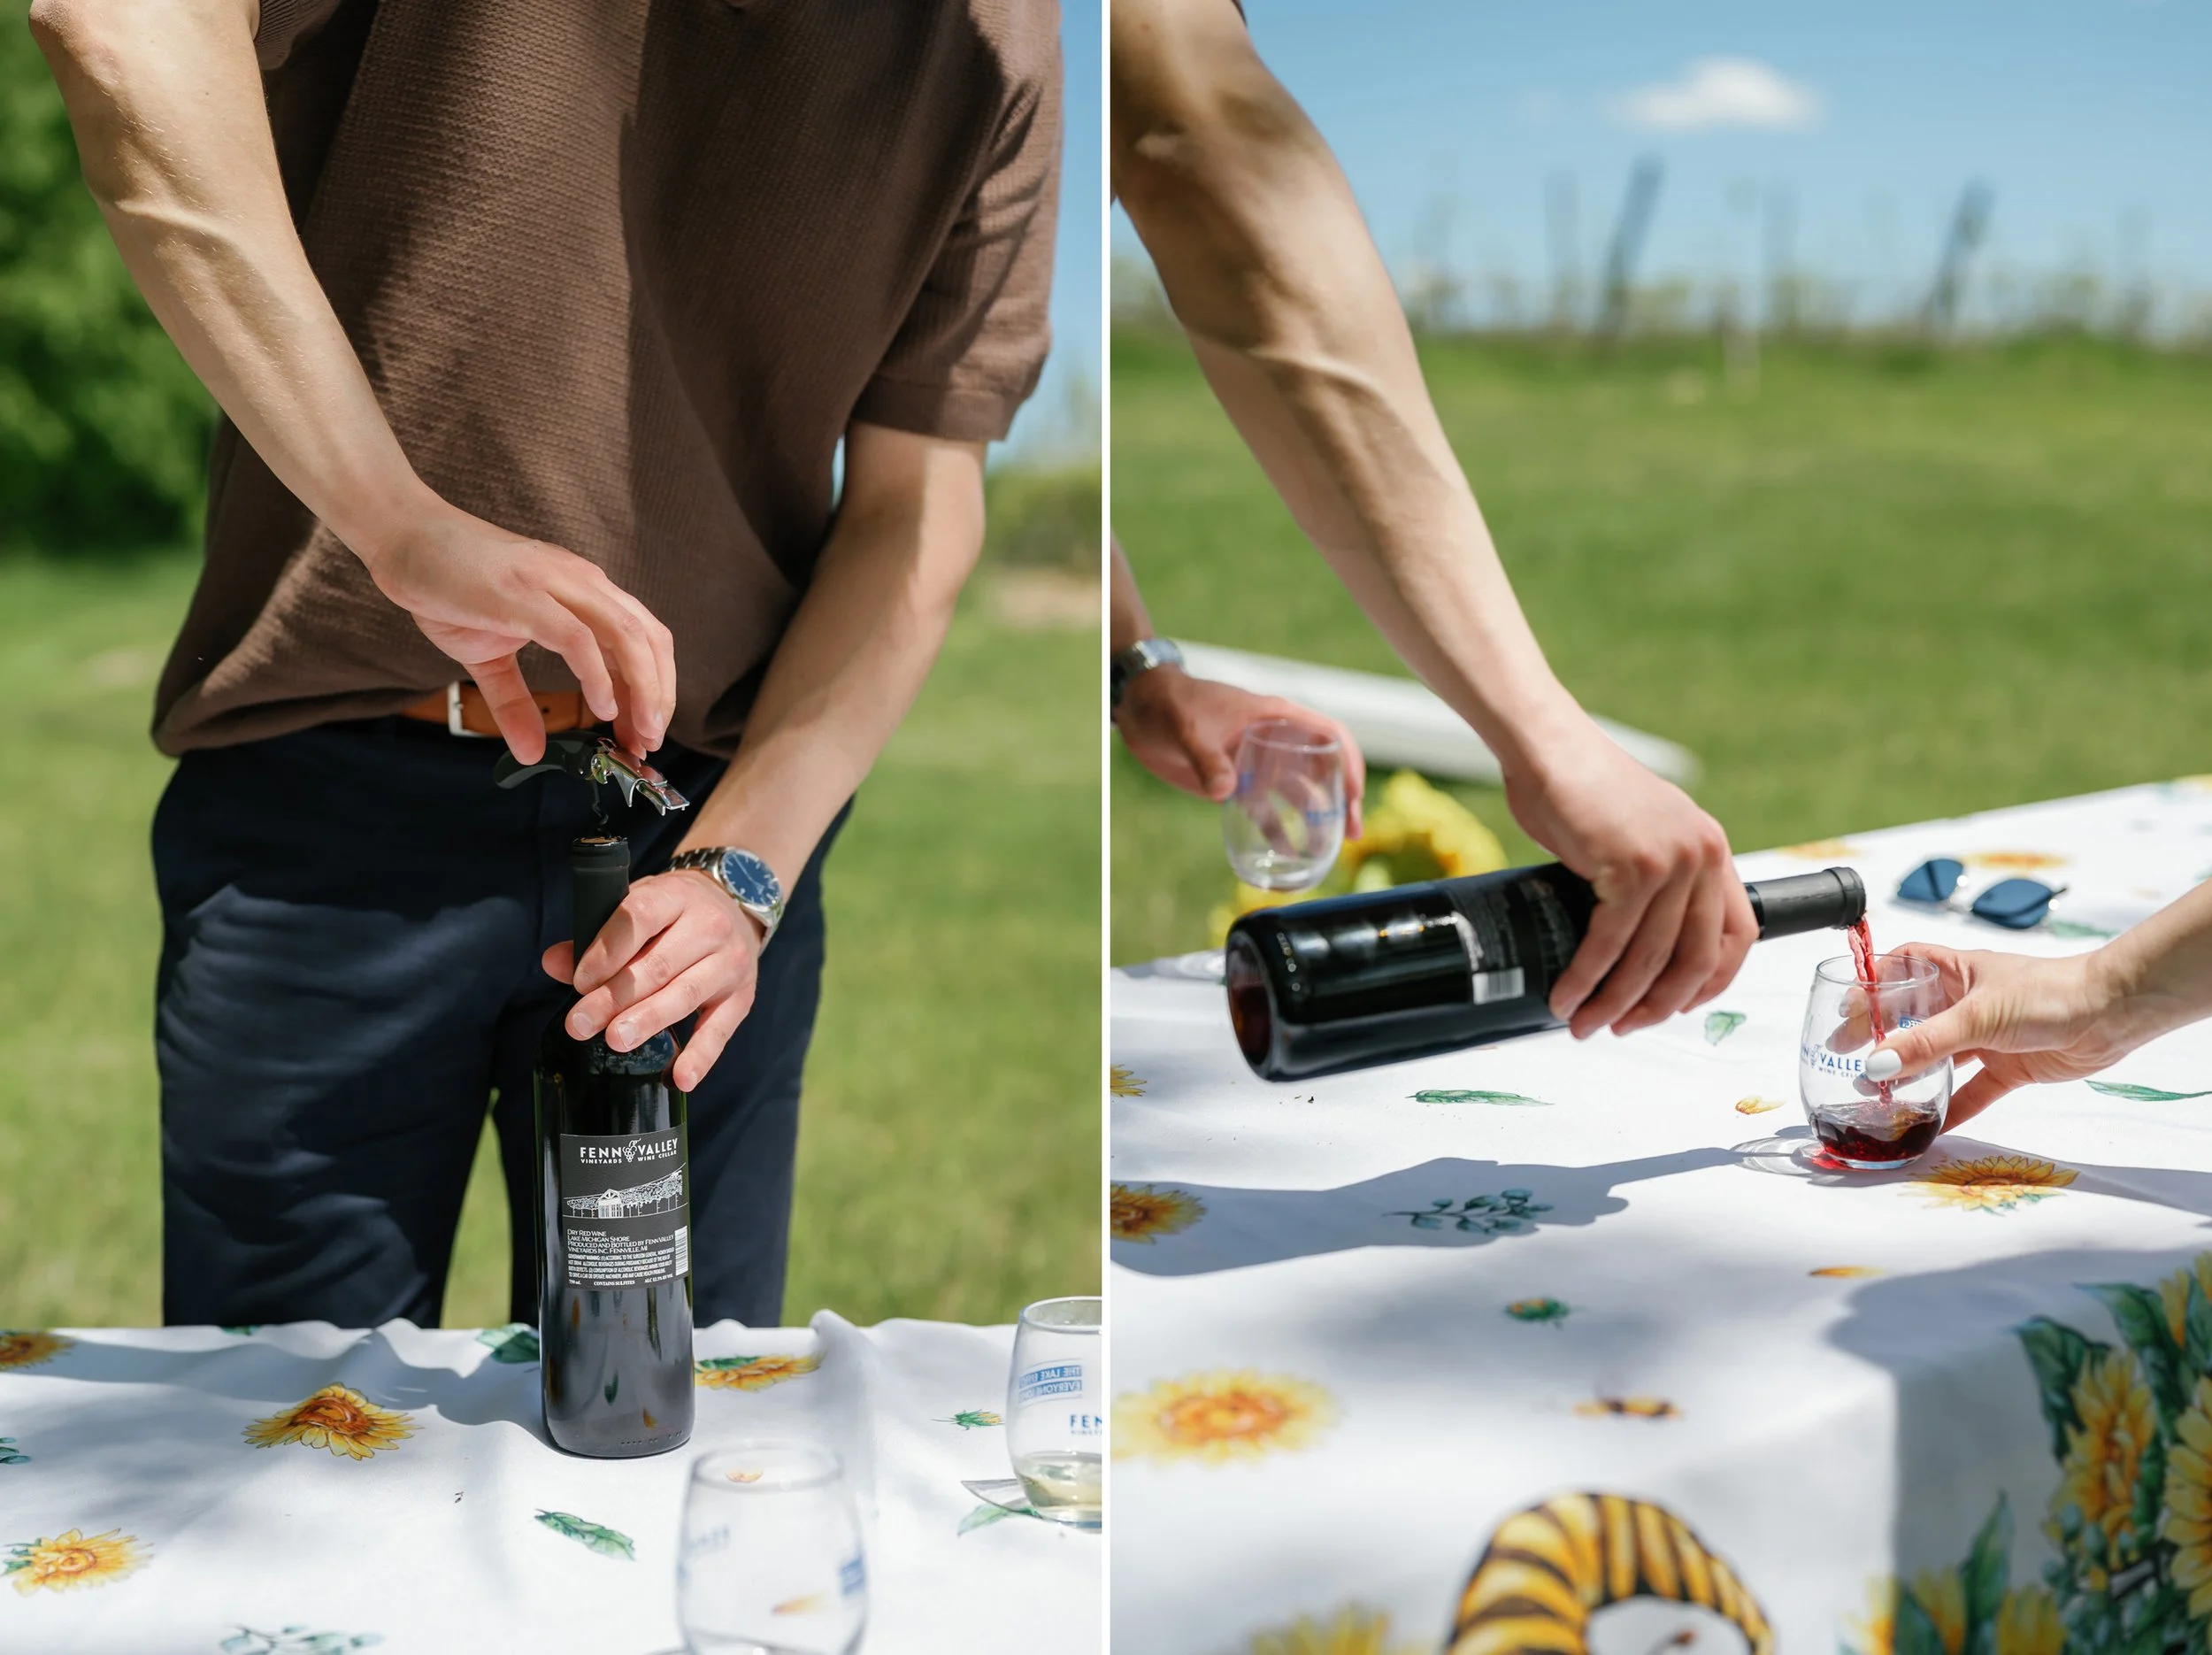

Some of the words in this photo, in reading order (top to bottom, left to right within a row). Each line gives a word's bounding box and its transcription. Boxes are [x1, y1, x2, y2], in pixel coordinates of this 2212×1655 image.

[1820, 1052, 1862, 1072] VALLE
[580, 1146, 622, 1158] FENN
[637, 1137, 679, 1156] VALLEY
[657, 1150, 677, 1159] CELLAR
